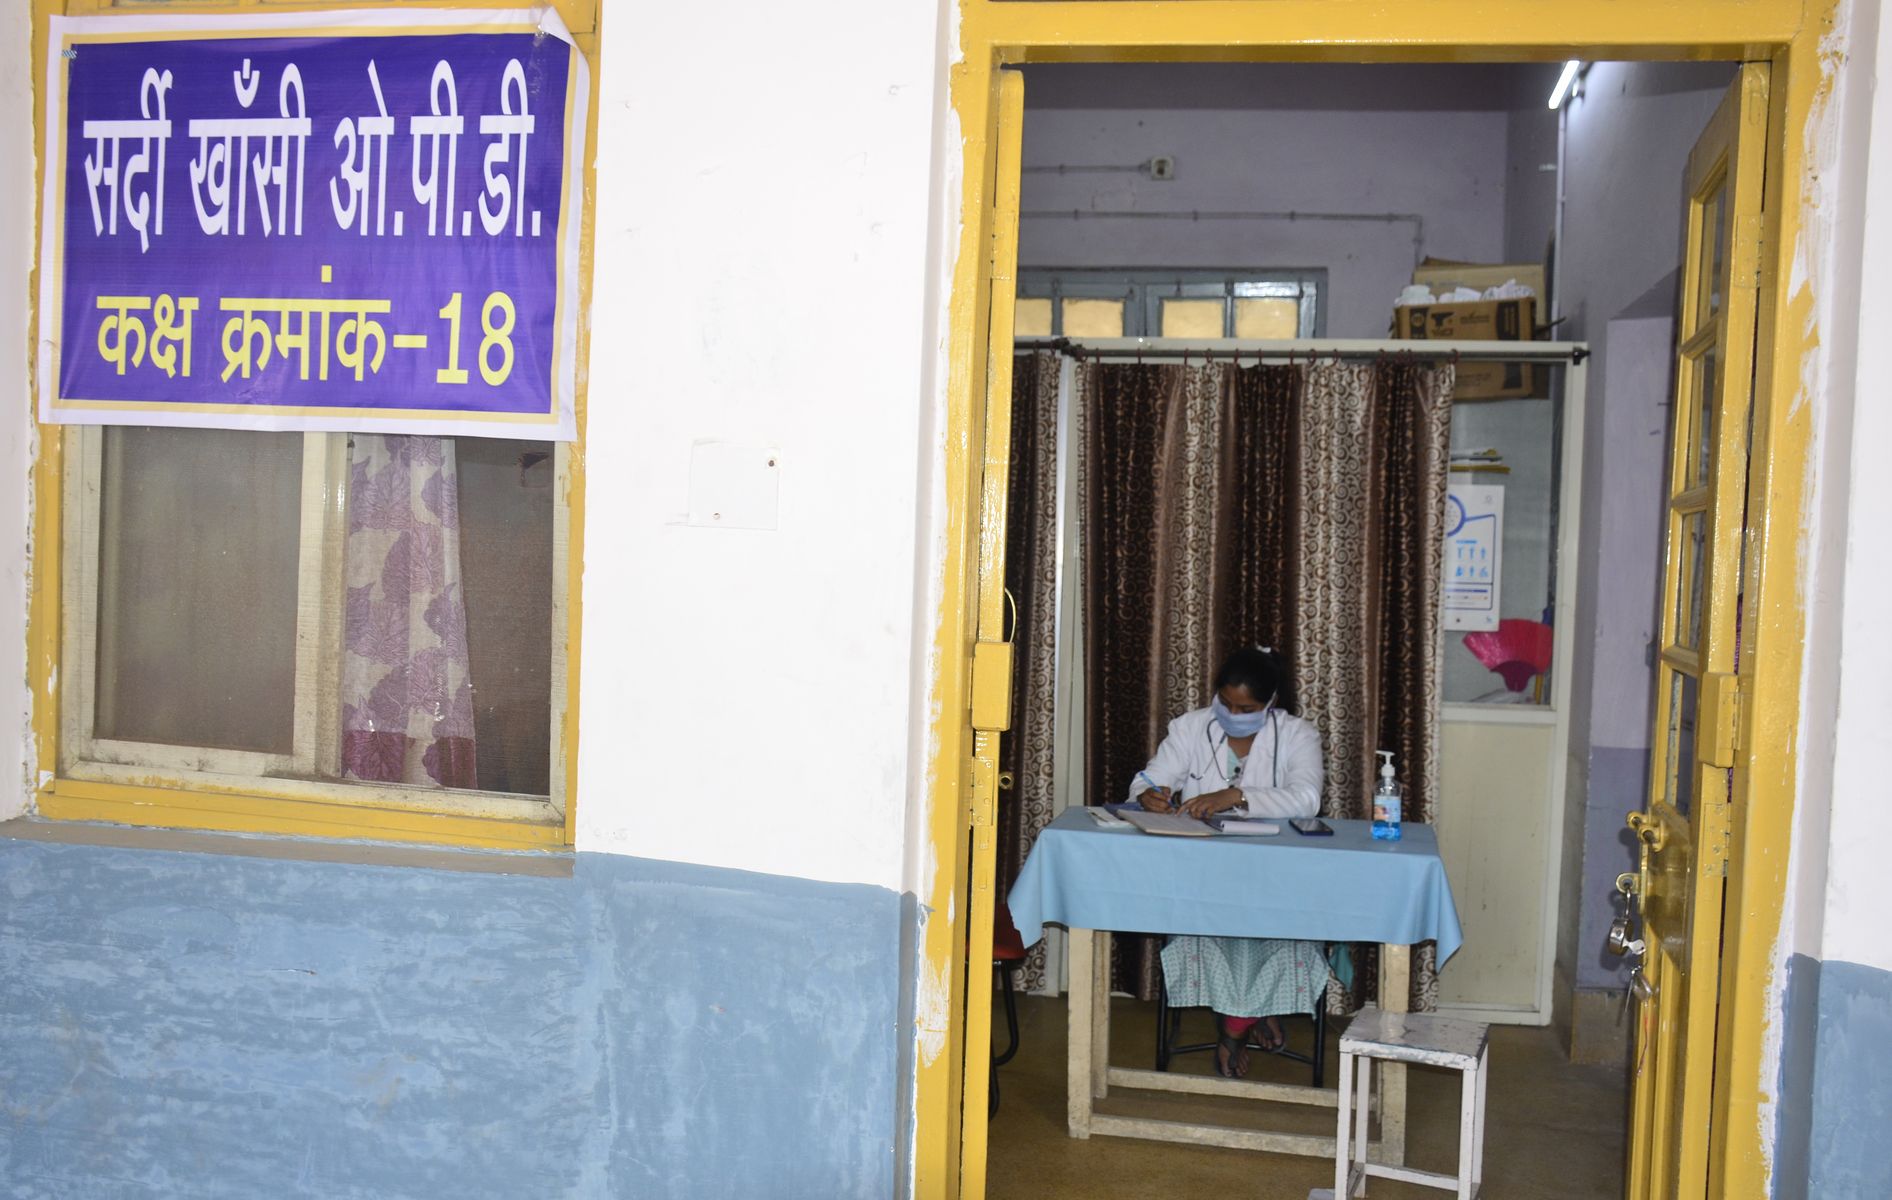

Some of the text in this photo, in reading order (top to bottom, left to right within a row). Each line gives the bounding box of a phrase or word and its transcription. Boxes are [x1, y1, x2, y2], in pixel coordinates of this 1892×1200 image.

[84, 58, 541, 254] सर्दी खाँसी ओ.पी.डी.
[96, 293, 200, 379] कक्ष
